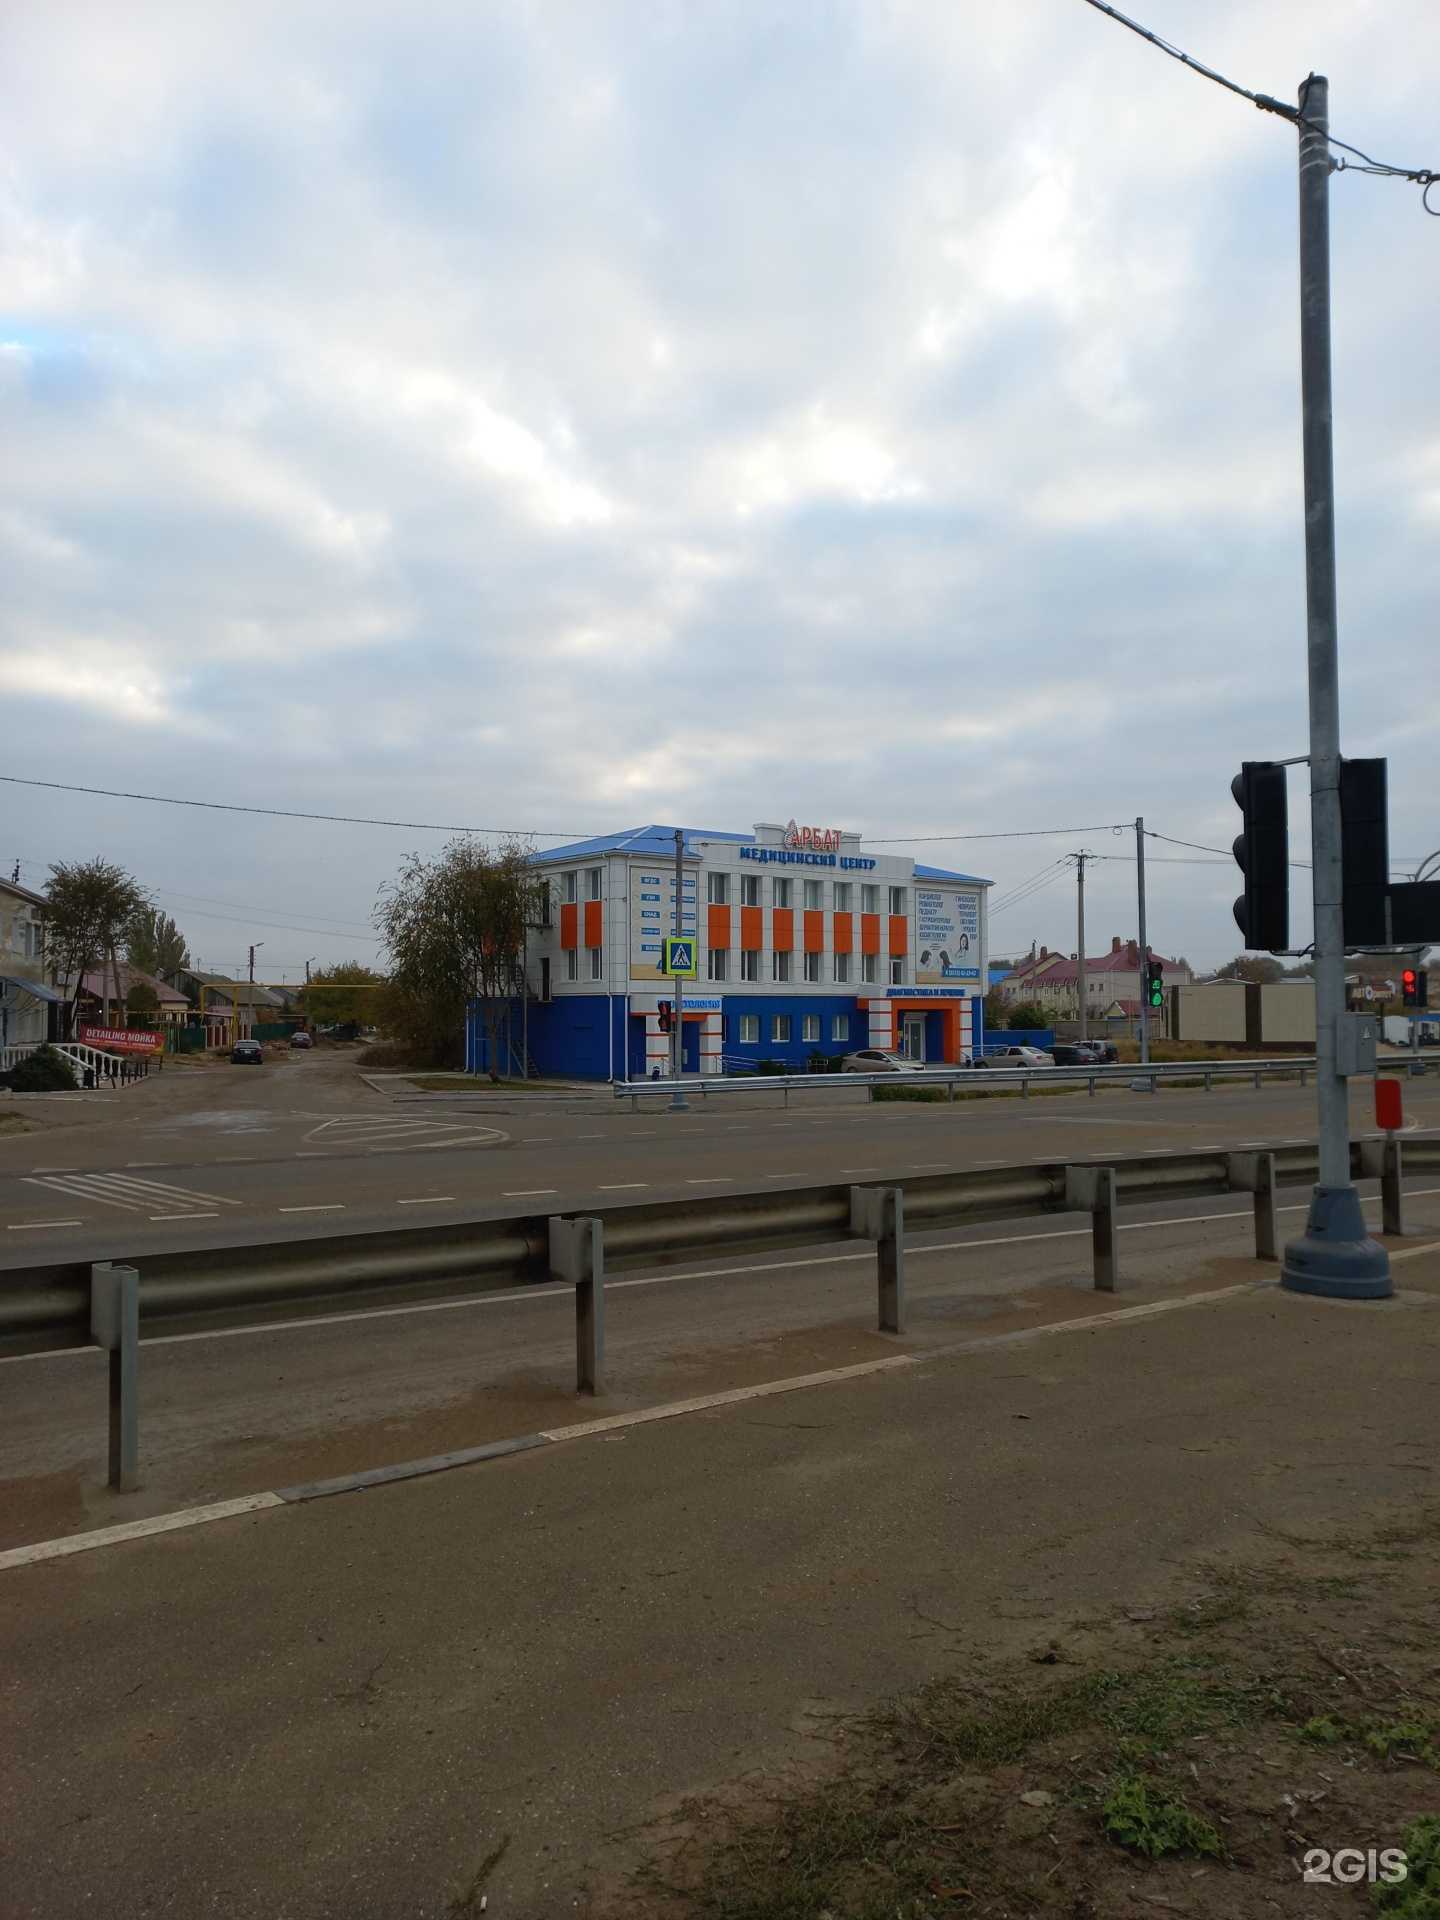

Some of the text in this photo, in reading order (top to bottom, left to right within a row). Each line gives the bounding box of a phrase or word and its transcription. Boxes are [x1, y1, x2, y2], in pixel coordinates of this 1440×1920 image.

[785, 820, 842, 851] АРБАТ
[740, 847, 876, 870] МЕДИЦИНСКИЙ ЦЕНТР
[86, 1028, 126, 1040] DETAILING
[127, 1032, 156, 1043] МОЙКА
